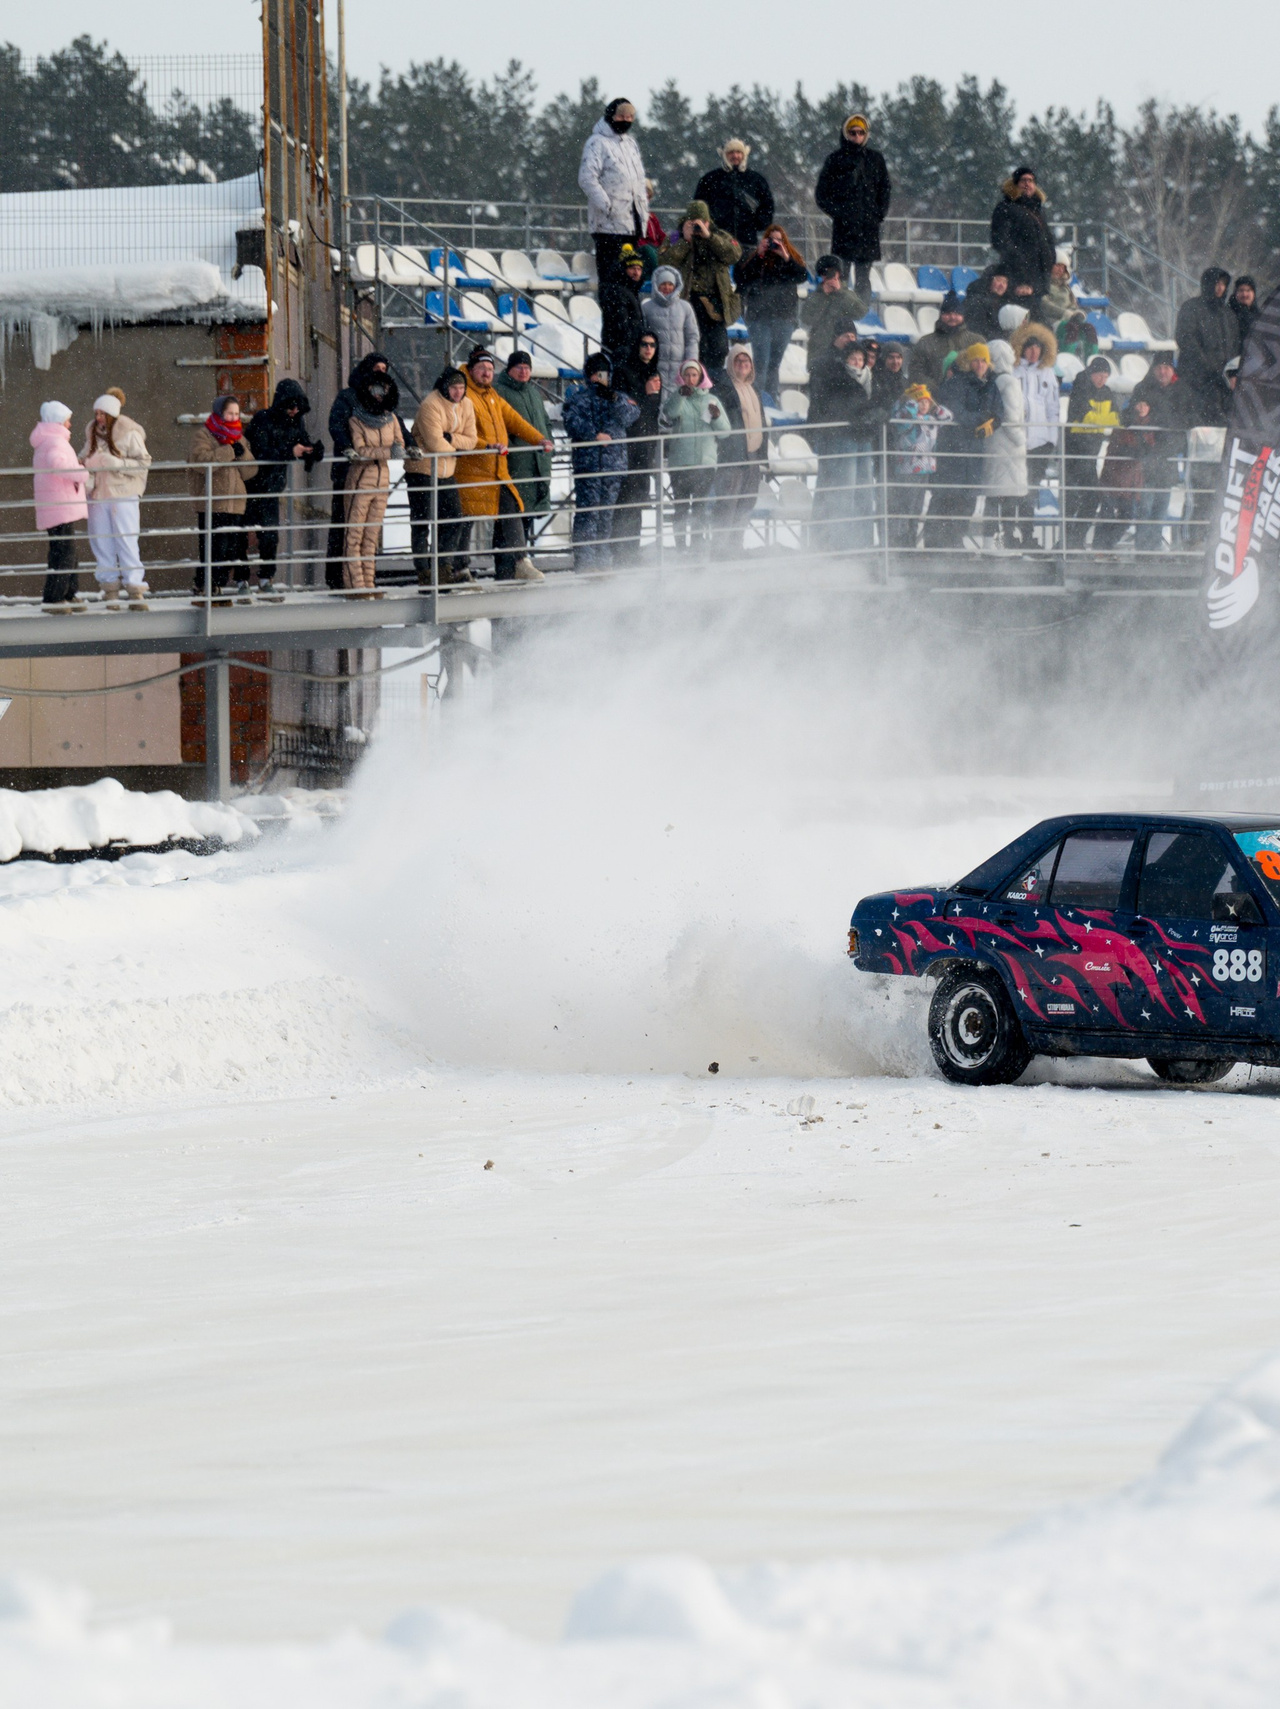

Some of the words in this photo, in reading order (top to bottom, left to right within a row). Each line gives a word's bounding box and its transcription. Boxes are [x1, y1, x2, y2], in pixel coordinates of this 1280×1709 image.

[1215, 437, 1258, 575] DRIFT
[1243, 459, 1265, 512] EXPO
[1212, 949, 1262, 982] 888
